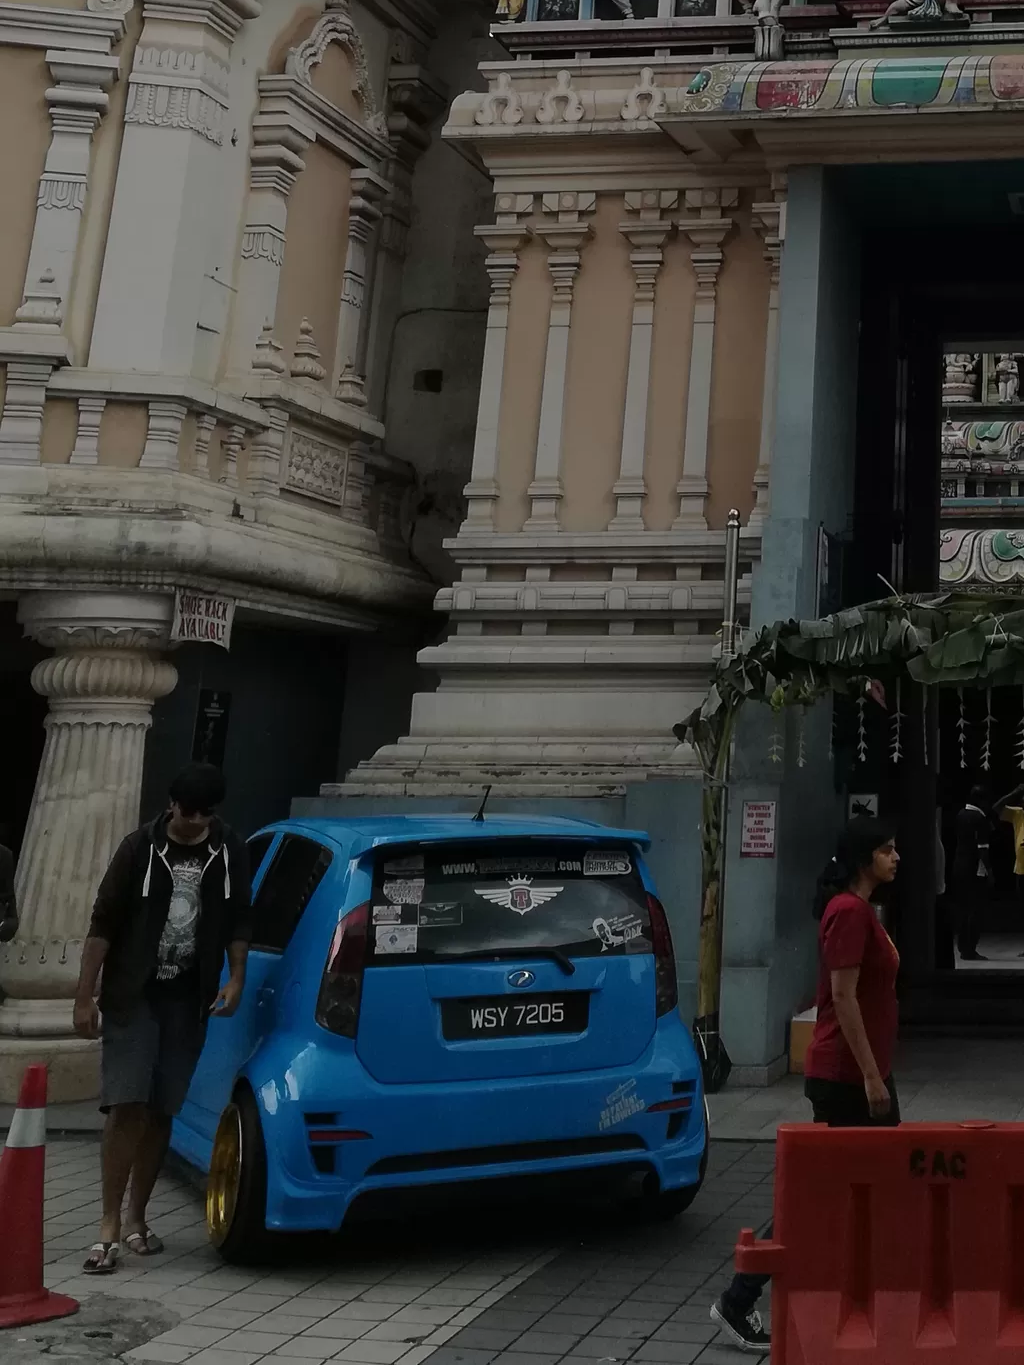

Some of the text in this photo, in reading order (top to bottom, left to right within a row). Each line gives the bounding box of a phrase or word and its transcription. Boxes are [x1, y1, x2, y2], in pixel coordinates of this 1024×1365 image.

[179, 595, 229, 622] SHOE RACK
[470, 1002, 564, 1029] WSY 7205
